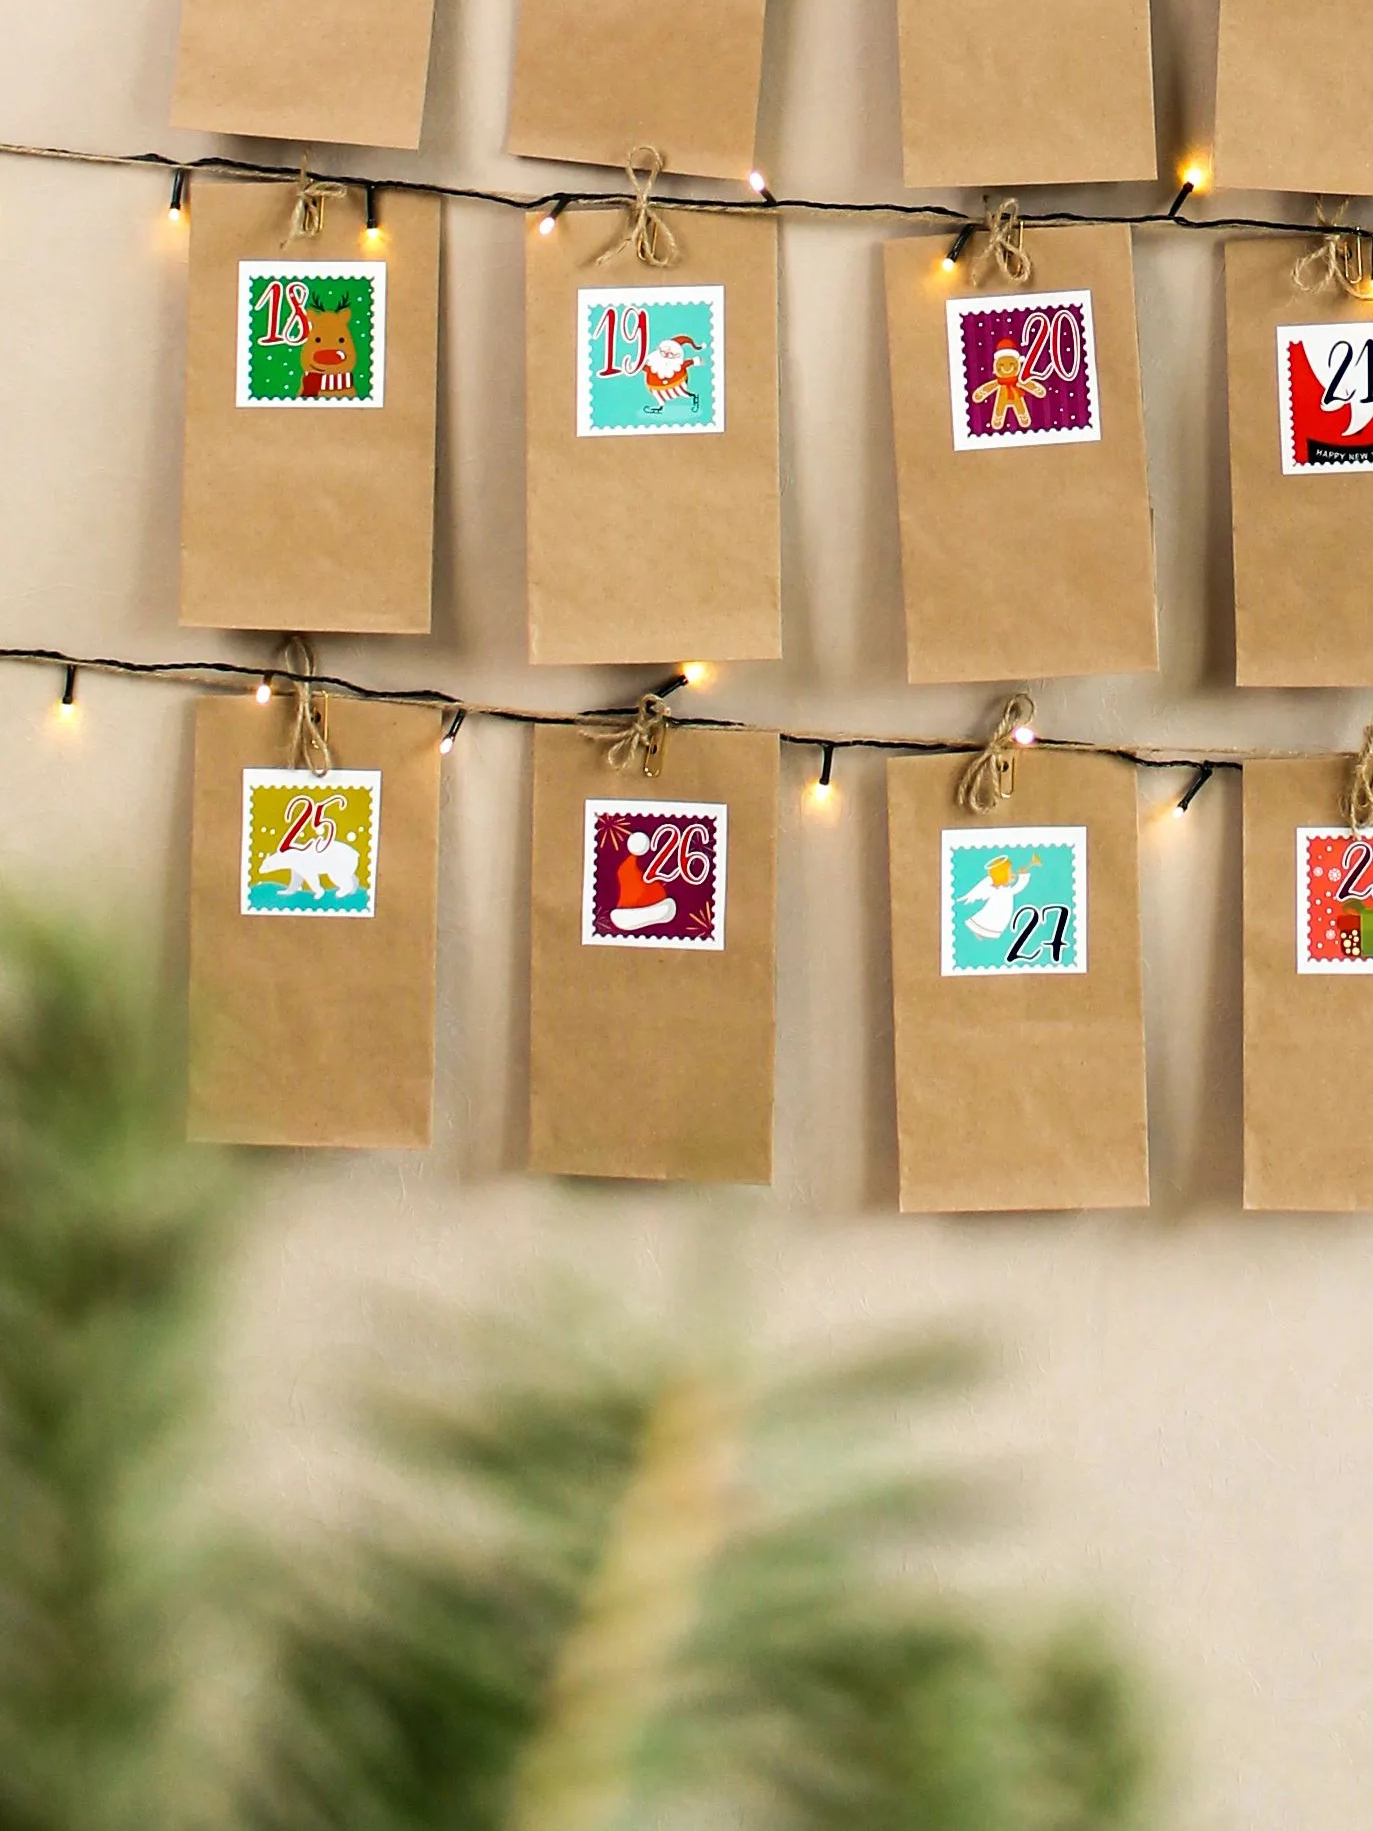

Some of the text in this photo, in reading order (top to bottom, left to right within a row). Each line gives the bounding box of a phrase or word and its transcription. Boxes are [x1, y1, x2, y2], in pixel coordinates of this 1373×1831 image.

[255, 281, 312, 346] 18
[592, 307, 649, 378] 19
[1020, 310, 1081, 383] 20
[1316, 449, 1345, 460] HAPPY
[1348, 453, 1368, 461] NEW
[280, 795, 346, 852] 25
[643, 823, 710, 885] 26
[1006, 905, 1070, 963] 27
